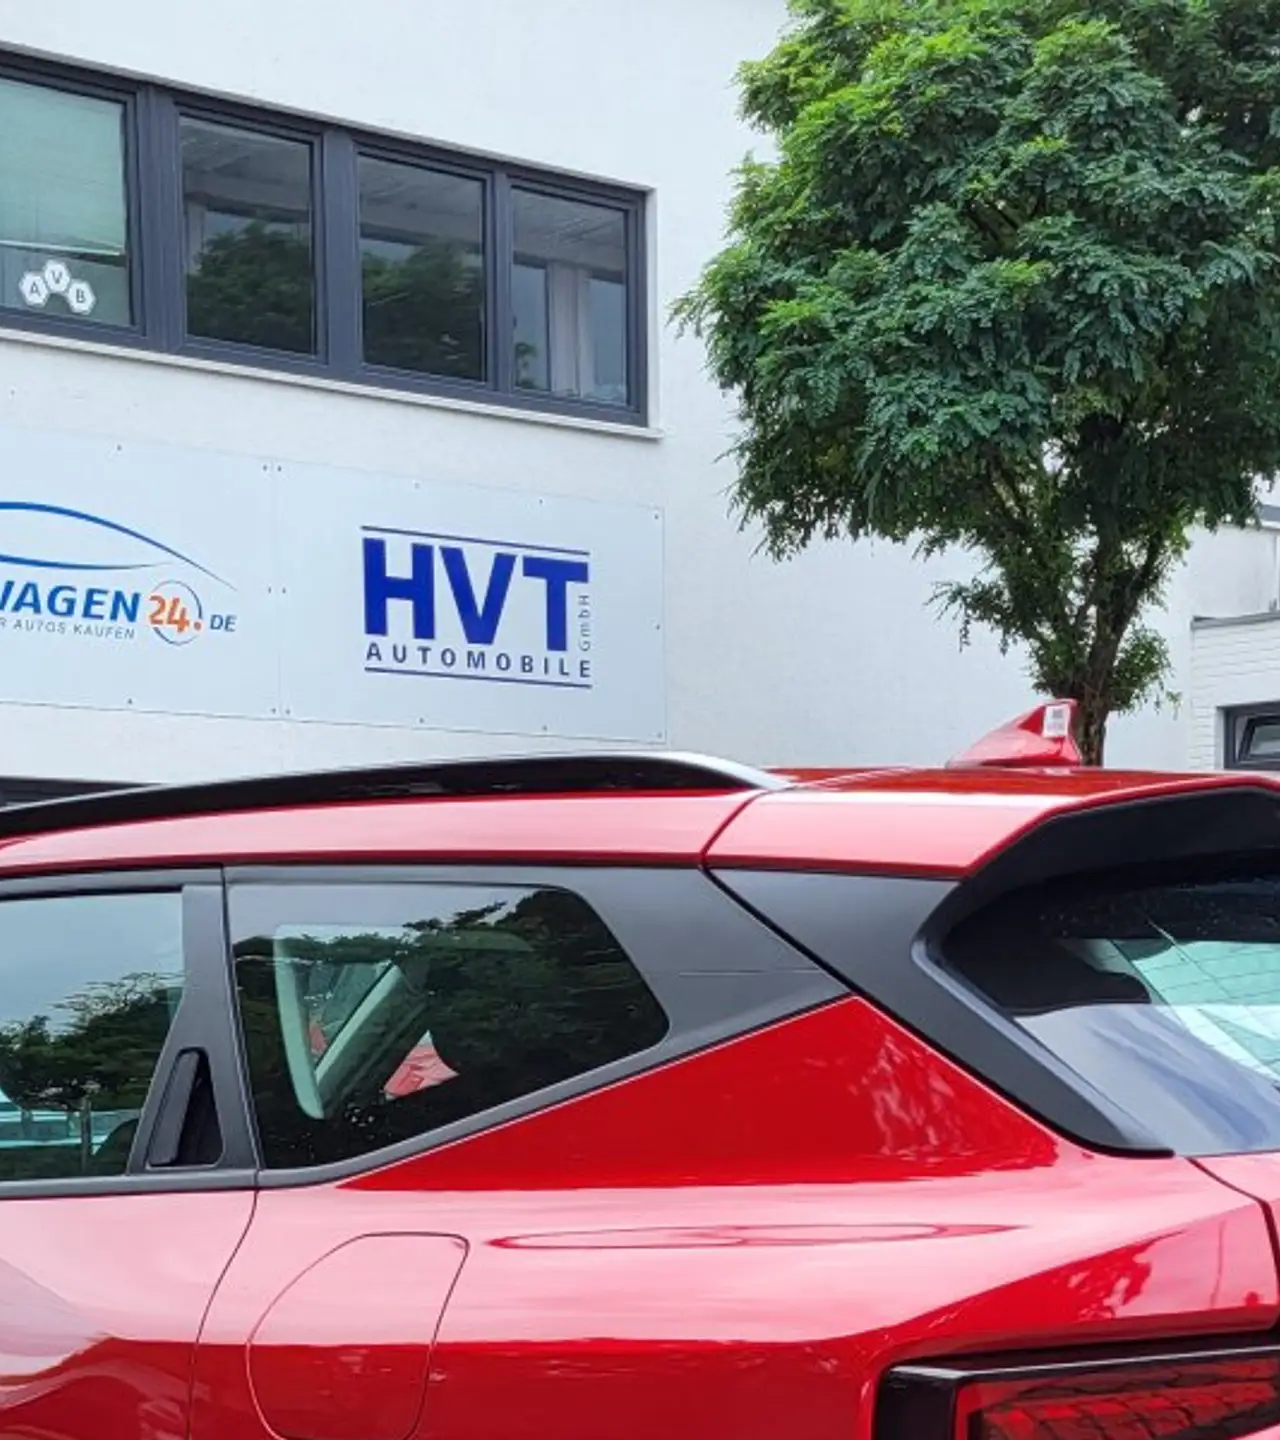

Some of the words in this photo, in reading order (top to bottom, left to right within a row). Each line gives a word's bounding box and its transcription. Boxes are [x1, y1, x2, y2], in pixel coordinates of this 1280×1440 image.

[363, 537, 589, 652] HVT
[13, 618, 67, 635] AUTOS
[73, 624, 136, 641] KAUFEN
[577, 594, 591, 652] GmbH
[365, 641, 591, 679] AUTOMOBILE
